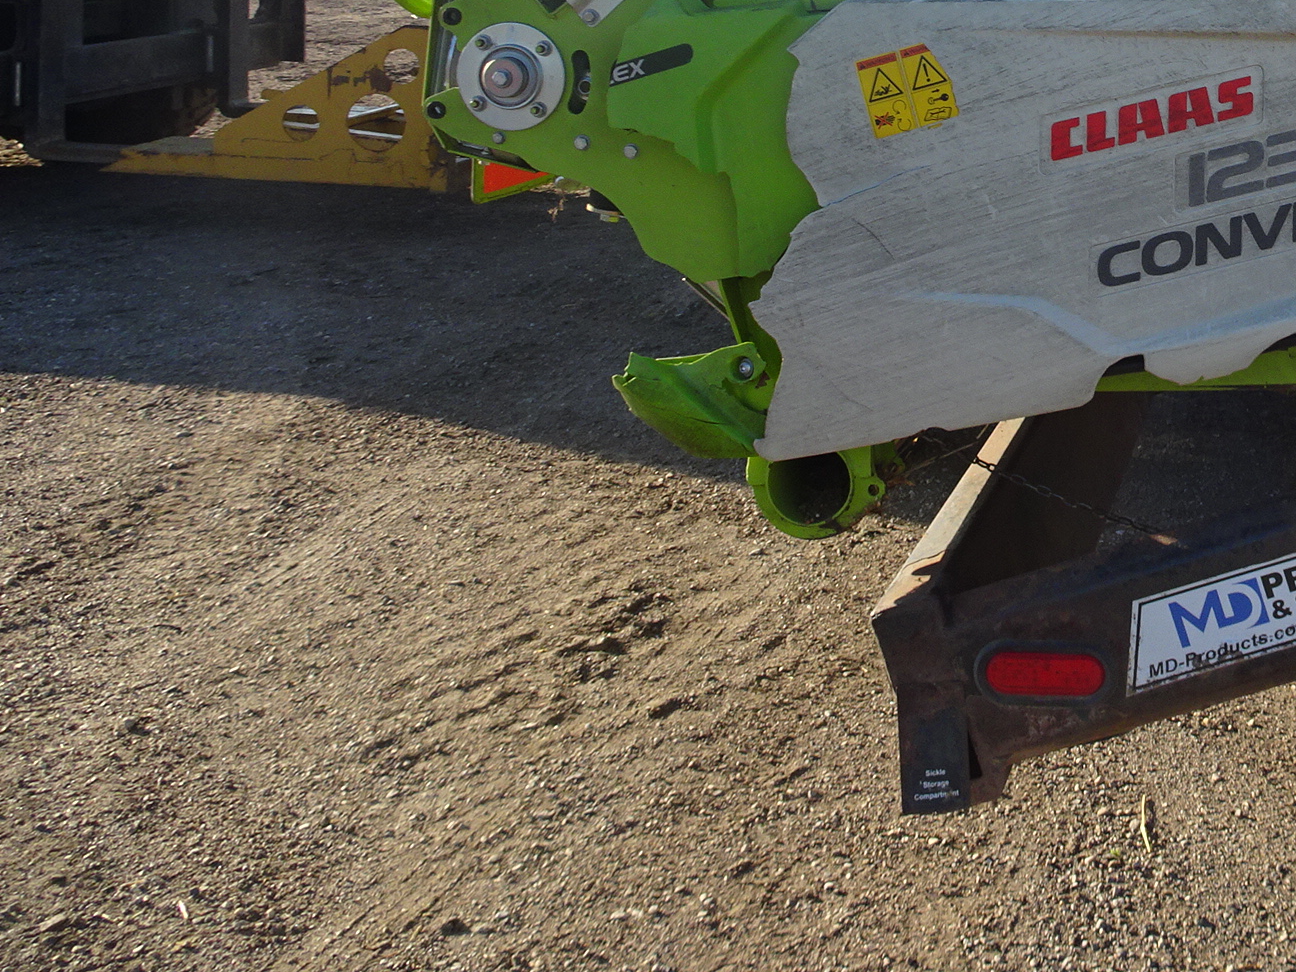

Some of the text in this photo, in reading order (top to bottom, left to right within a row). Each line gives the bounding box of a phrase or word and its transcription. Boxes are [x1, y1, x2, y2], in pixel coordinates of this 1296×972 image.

[1050, 75, 1255, 162] CLAAS
[1168, 578, 1270, 649] MD
[1271, 599, 1293, 621] &
[925, 768, 946, 777] Sickle
[922, 779, 950, 789] Storage
